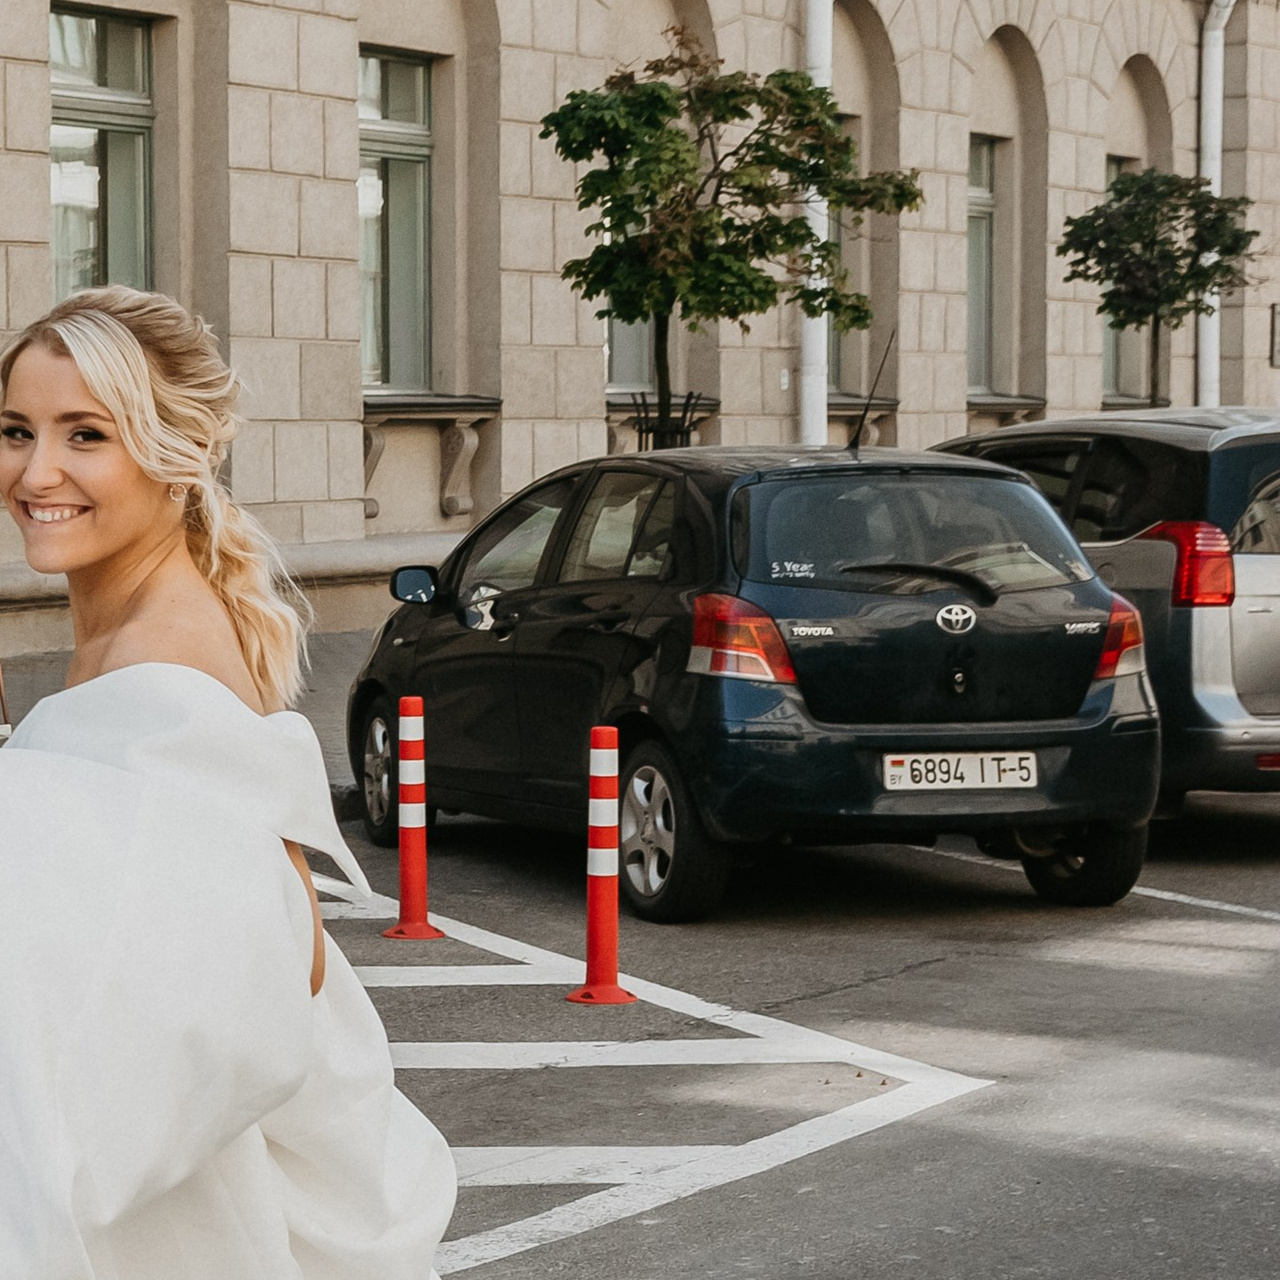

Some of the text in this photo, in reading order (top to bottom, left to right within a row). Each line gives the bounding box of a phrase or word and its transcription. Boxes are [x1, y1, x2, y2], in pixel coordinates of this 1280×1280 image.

[791, 626, 834, 636] TOYOTA
[910, 758, 966, 784] 6894
[890, 774, 903, 785] BY
